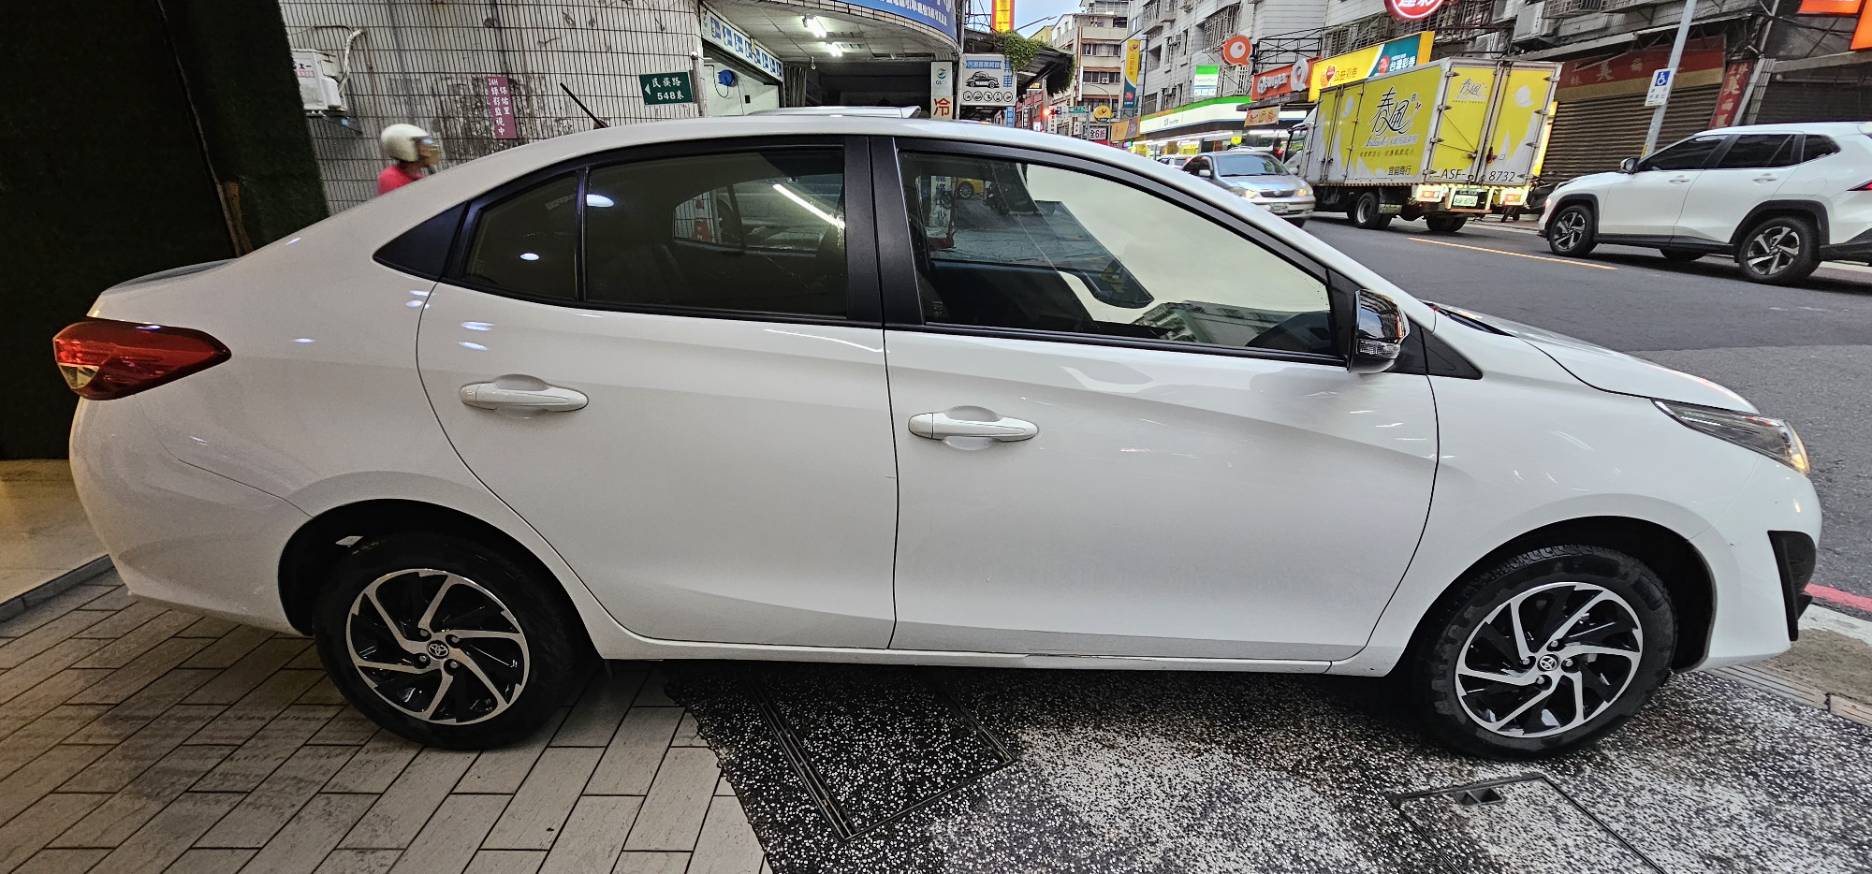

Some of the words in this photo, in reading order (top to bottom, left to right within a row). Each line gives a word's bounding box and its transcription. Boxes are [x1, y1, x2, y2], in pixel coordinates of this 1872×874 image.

[651, 77, 682, 88] 民族路
[657, 90, 684, 101] 548巷
[933, 97, 951, 117] 冷
[1488, 170, 1516, 183] 8732
